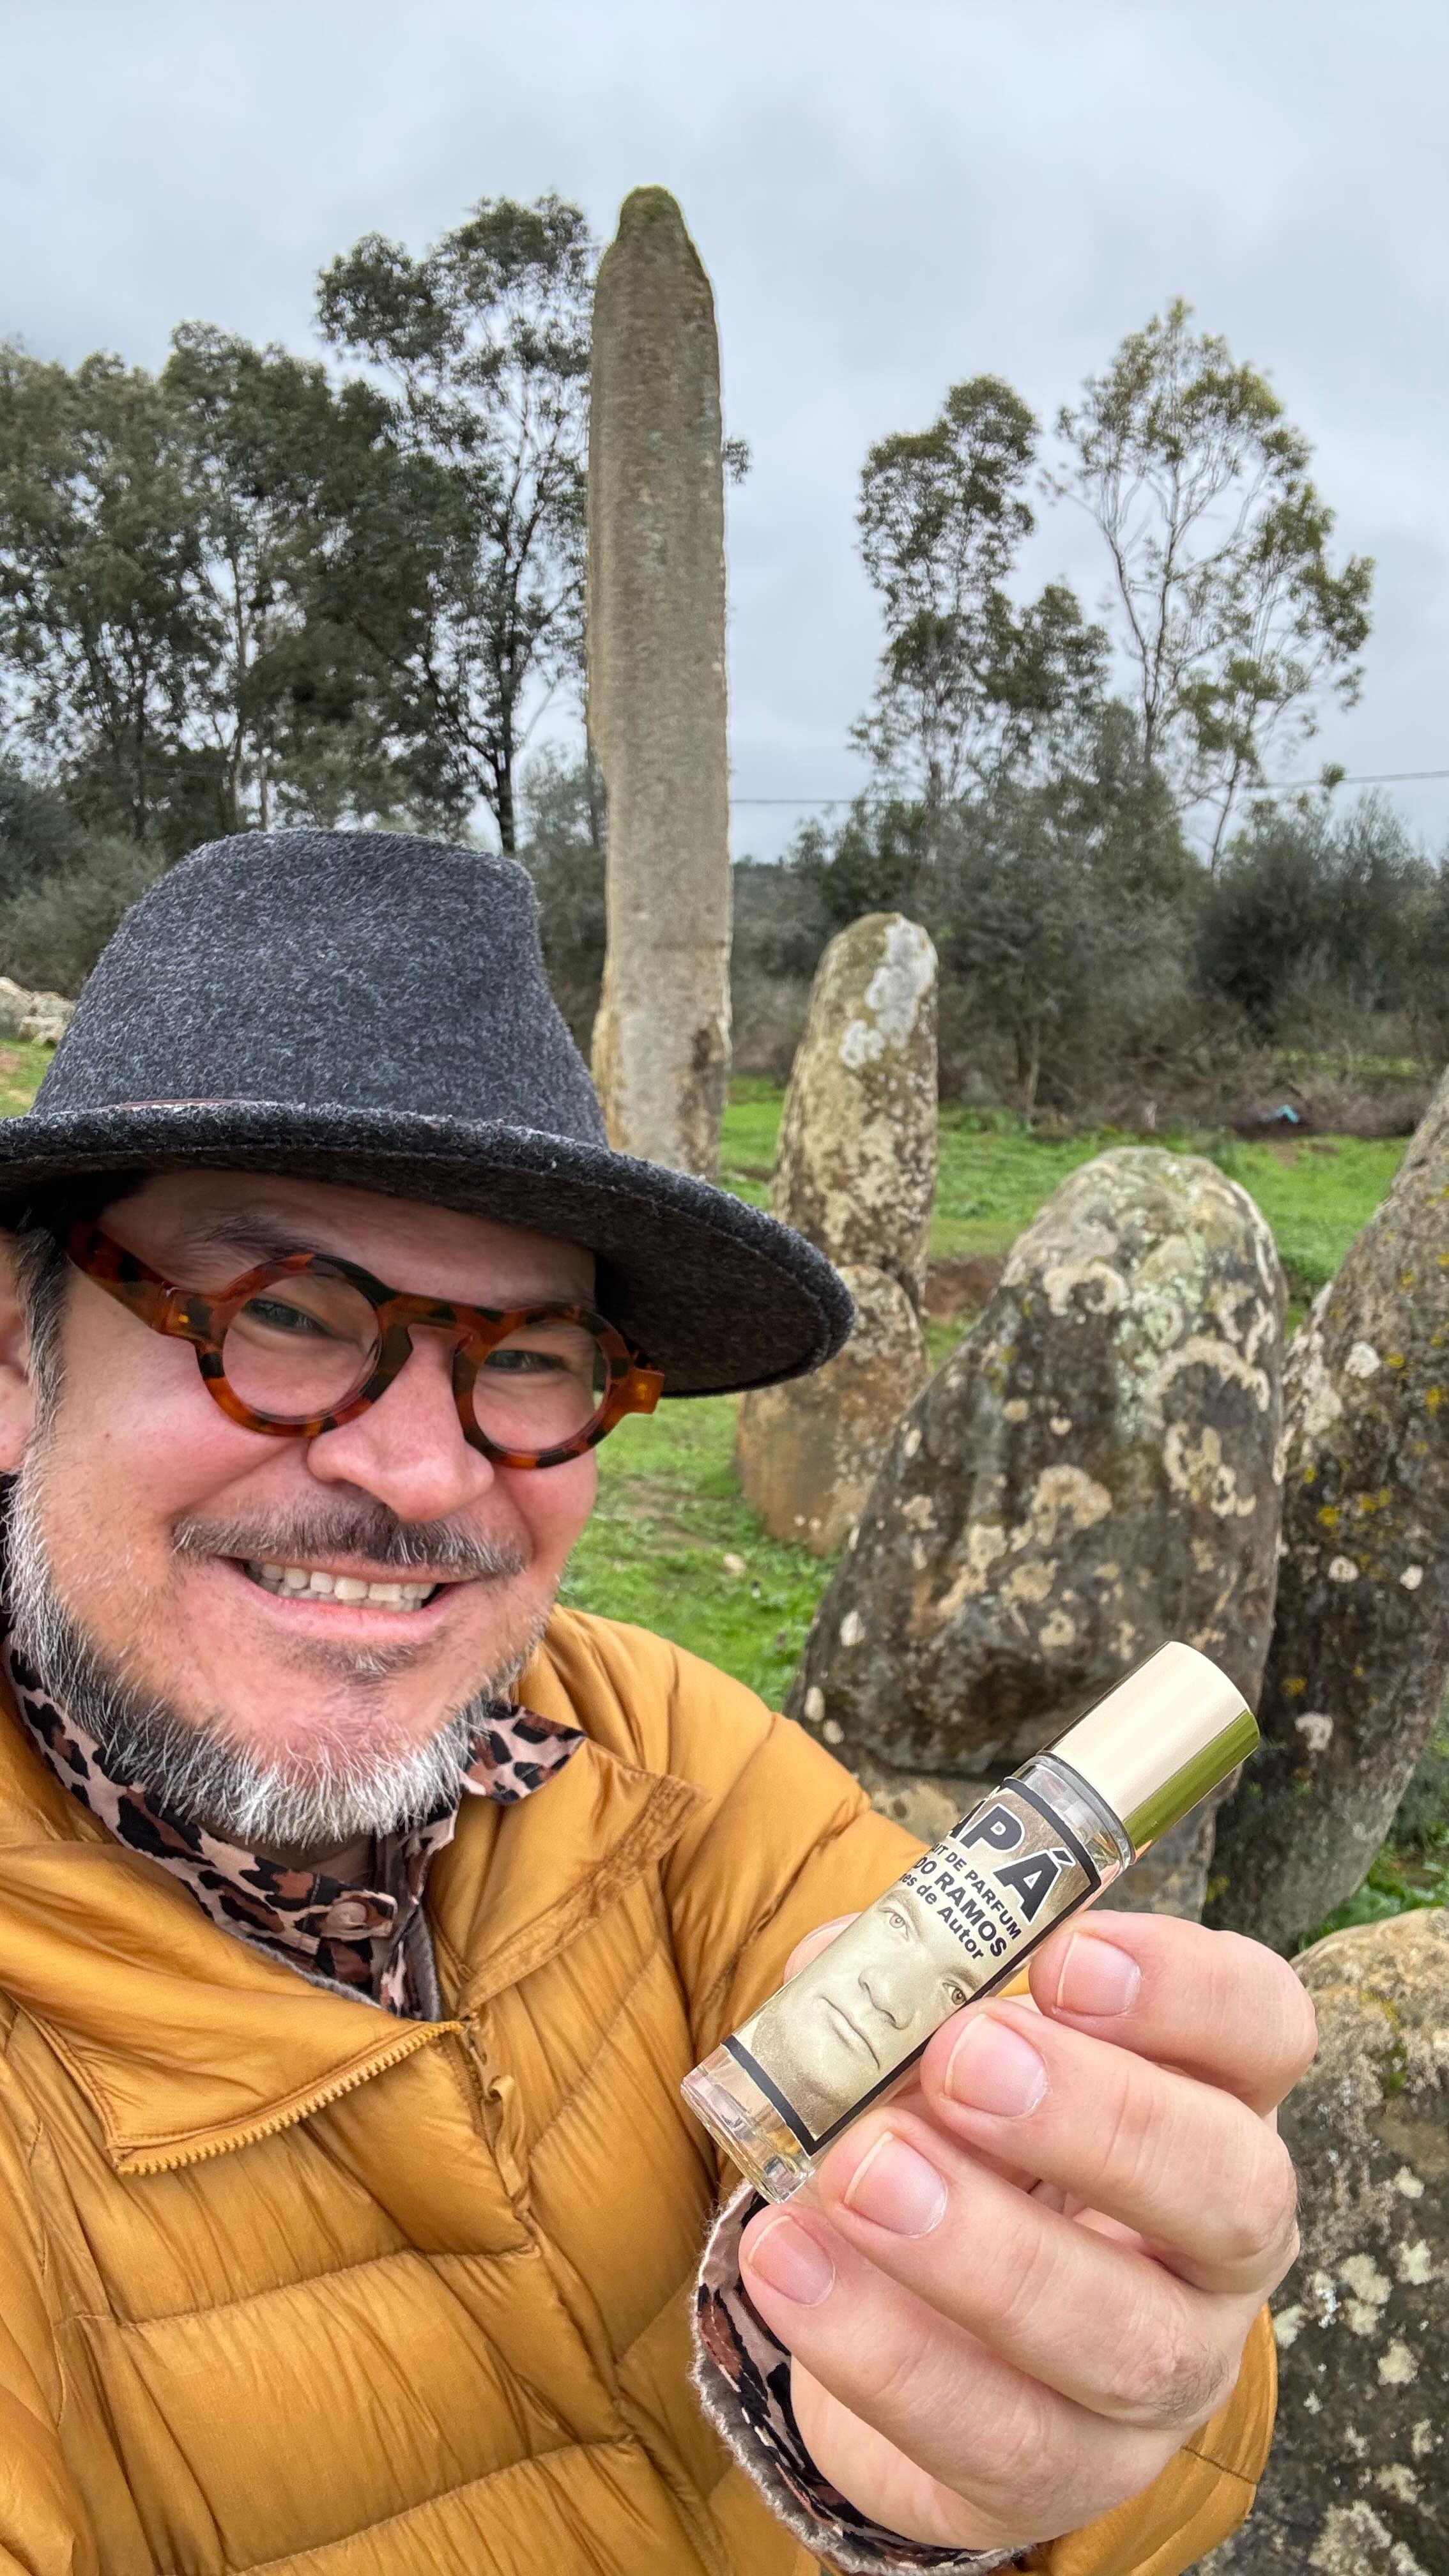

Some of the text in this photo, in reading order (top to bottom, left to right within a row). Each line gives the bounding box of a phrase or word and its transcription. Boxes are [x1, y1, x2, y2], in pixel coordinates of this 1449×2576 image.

[916, 1885, 938, 1905] de
[937, 1906, 985, 1959] Autor
[934, 1871, 1007, 1957] RAMOS
[945, 1851, 968, 1872] DE
[965, 1869, 1022, 1940] PARFUM
